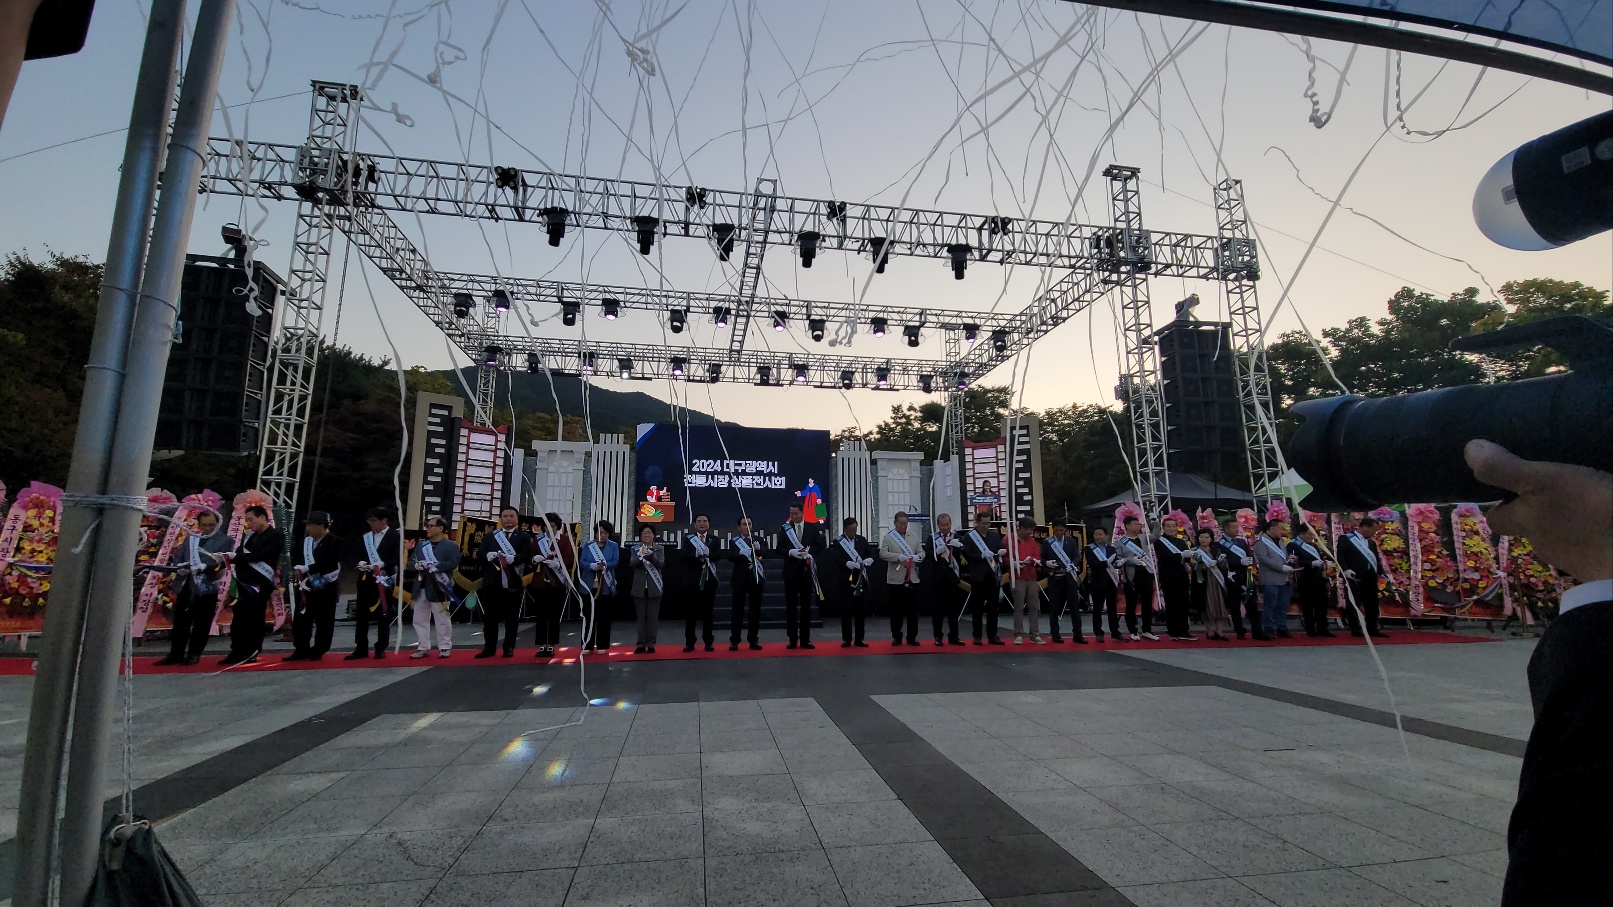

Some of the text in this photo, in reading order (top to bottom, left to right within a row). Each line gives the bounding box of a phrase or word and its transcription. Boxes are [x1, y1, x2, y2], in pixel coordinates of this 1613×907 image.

[692, 459, 777, 473] 2024 대구광역시
[731, 476, 785, 488] 상품전시회
[0, 514, 21, 558] 동구시장
